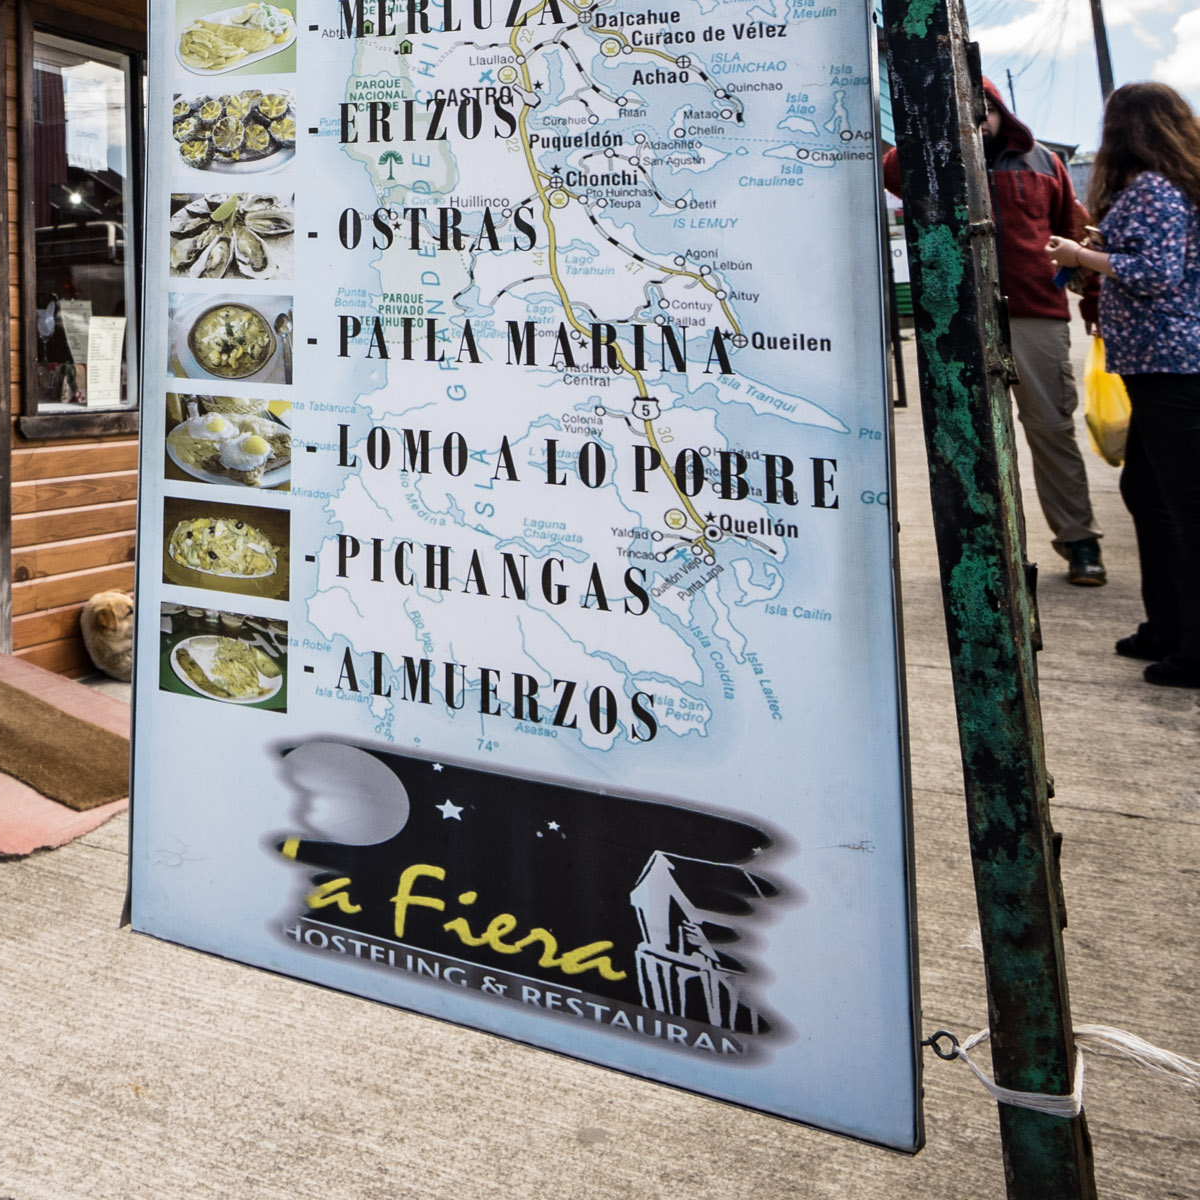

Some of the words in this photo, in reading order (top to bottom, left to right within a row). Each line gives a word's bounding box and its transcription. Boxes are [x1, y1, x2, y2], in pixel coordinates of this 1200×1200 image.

[595, 9, 681, 29] Dalcahue
[520, 28, 535, 44] 22
[632, 29, 696, 47] Curaco
[703, 26, 726, 43] de
[732, 20, 788, 40] Vélez
[469, 55, 515, 67] Llaullao
[711, 51, 741, 63] ISLA
[711, 60, 788, 75] QUINCHAO
[830, 64, 853, 74] Isla
[632, 68, 690, 86] Achao
[830, 75, 870, 88] Apiao
[355, 79, 401, 90] PARQUE
[727, 82, 783, 94] Quinchao
[350, 90, 408, 101] NACIONAL
[786, 92, 809, 103] Isla
[338, 96, 517, 144] ERIZOS
[683, 109, 719, 120] Matao
[543, 116, 587, 127] Curahue
[529, 130, 623, 152] Puqueldón
[642, 157, 663, 167] San
[811, 150, 875, 163] Chaulinec
[780, 164, 803, 175] Isla
[566, 169, 638, 187] Chonchi
[738, 175, 804, 188] Chaulinec
[586, 189, 603, 198] Pto
[606, 188, 653, 199] Huinchas
[449, 196, 510, 208] Huillinco
[610, 199, 641, 210] Teupa
[689, 199, 717, 210] Detif
[338, 206, 537, 251] OSTRAS
[690, 217, 738, 229] LEMUY
[565, 256, 594, 266] Lago
[712, 261, 752, 272] Lelbún
[337, 287, 367, 298] Punta
[383, 292, 424, 304] PARQUE
[729, 290, 760, 302] Aituy
[334, 297, 367, 308] Bonita
[671, 302, 713, 313] Contuy
[378, 304, 424, 316] PRIVADO
[526, 304, 554, 315] Lago
[337, 314, 484, 364] PAILA
[505, 320, 736, 375] MARINA
[751, 331, 832, 352] Queilen
[563, 373, 611, 387] Central
[716, 373, 741, 390] Isla
[642, 403, 651, 417] 5
[561, 413, 603, 425] Colonia
[563, 424, 604, 437] Yungay
[658, 426, 675, 444] 30
[858, 427, 883, 441] Pta
[337, 423, 469, 477] LOMO
[493, 435, 521, 482] A
[544, 438, 607, 489] LO
[632, 444, 840, 510] POBRE
[404, 493, 447, 527] Medina
[523, 517, 567, 531] Laguna
[719, 514, 799, 539] Quellón
[523, 528, 584, 544] Chaiguata
[611, 527, 649, 540] Yaldad
[617, 547, 655, 561] Trincao
[336, 533, 650, 616] PICHANGAS
[676, 580, 704, 602] Punta
[701, 563, 725, 585] Lapa
[765, 603, 788, 617] Isla
[302, 638, 332, 653] Roble
[335, 646, 658, 742] ALMUERZOS
[679, 698, 704, 711] San
[666, 707, 705, 724] Pedro
[515, 721, 559, 739] Asasao
[390, 863, 628, 981] Fiera
[284, 923, 469, 990] HOSTELING
[480, 974, 508, 999] &
